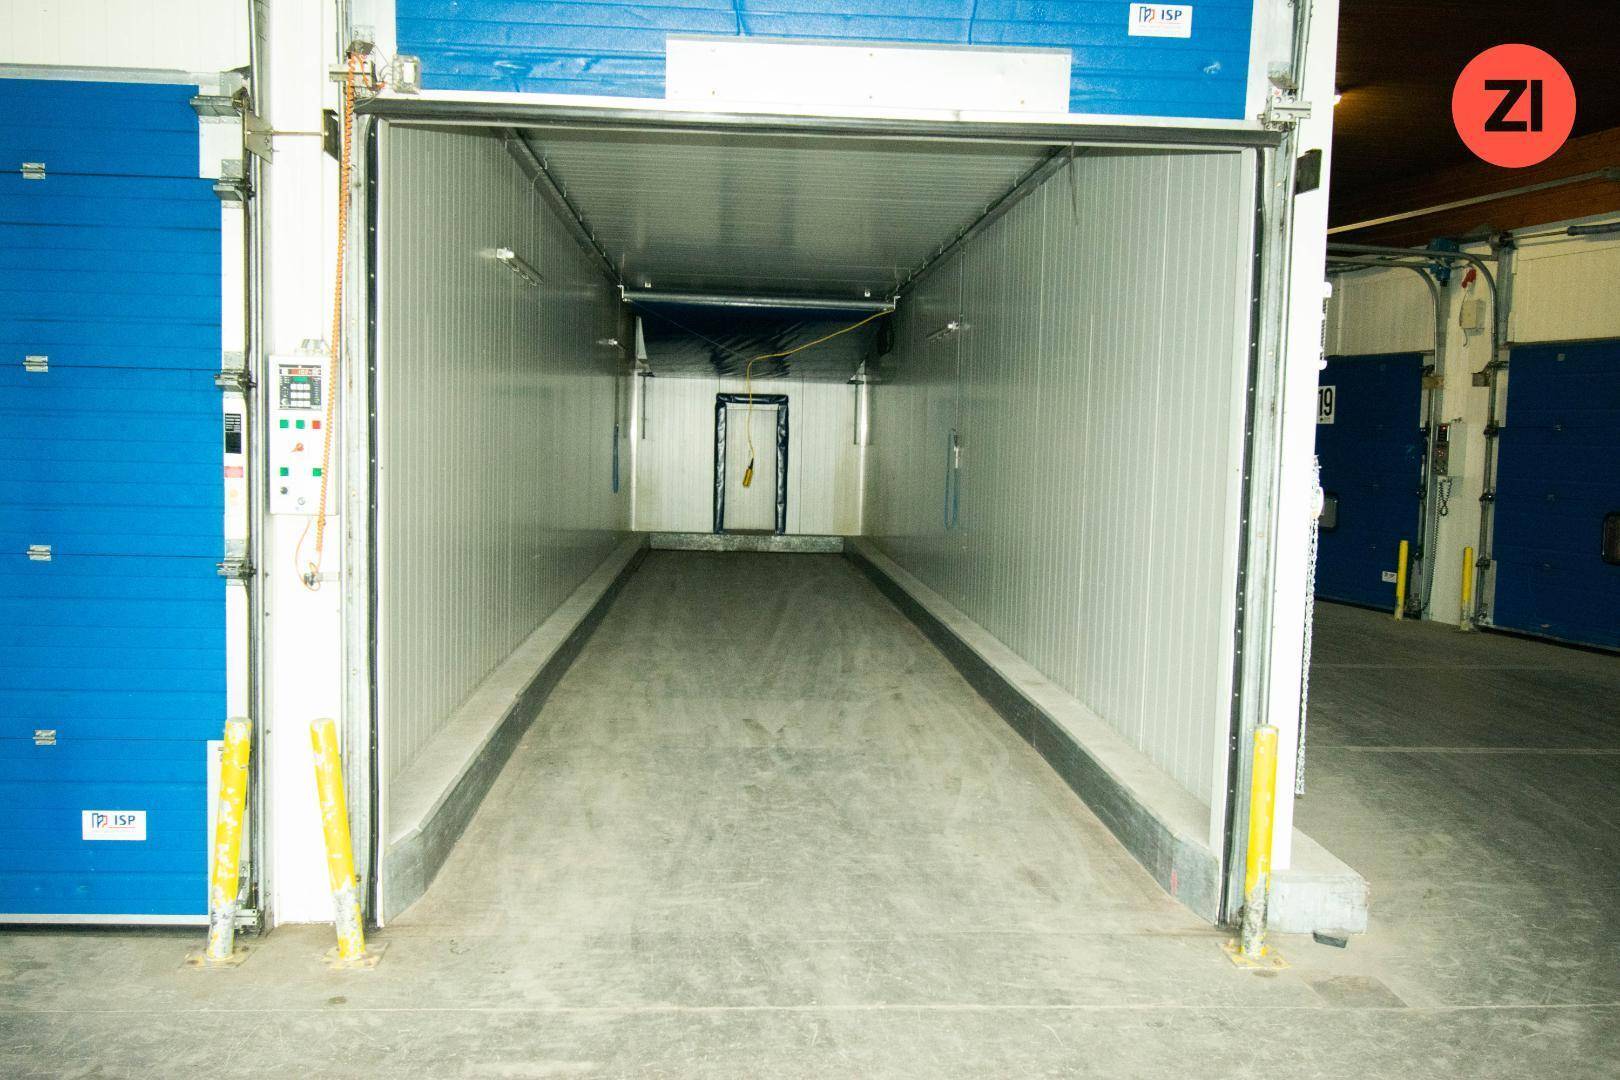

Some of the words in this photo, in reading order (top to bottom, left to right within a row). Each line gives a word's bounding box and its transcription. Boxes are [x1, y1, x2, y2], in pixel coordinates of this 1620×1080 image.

[1161, 9, 1182, 21] ISP
[1318, 387, 1333, 416] 19
[114, 815, 136, 826] ISP
